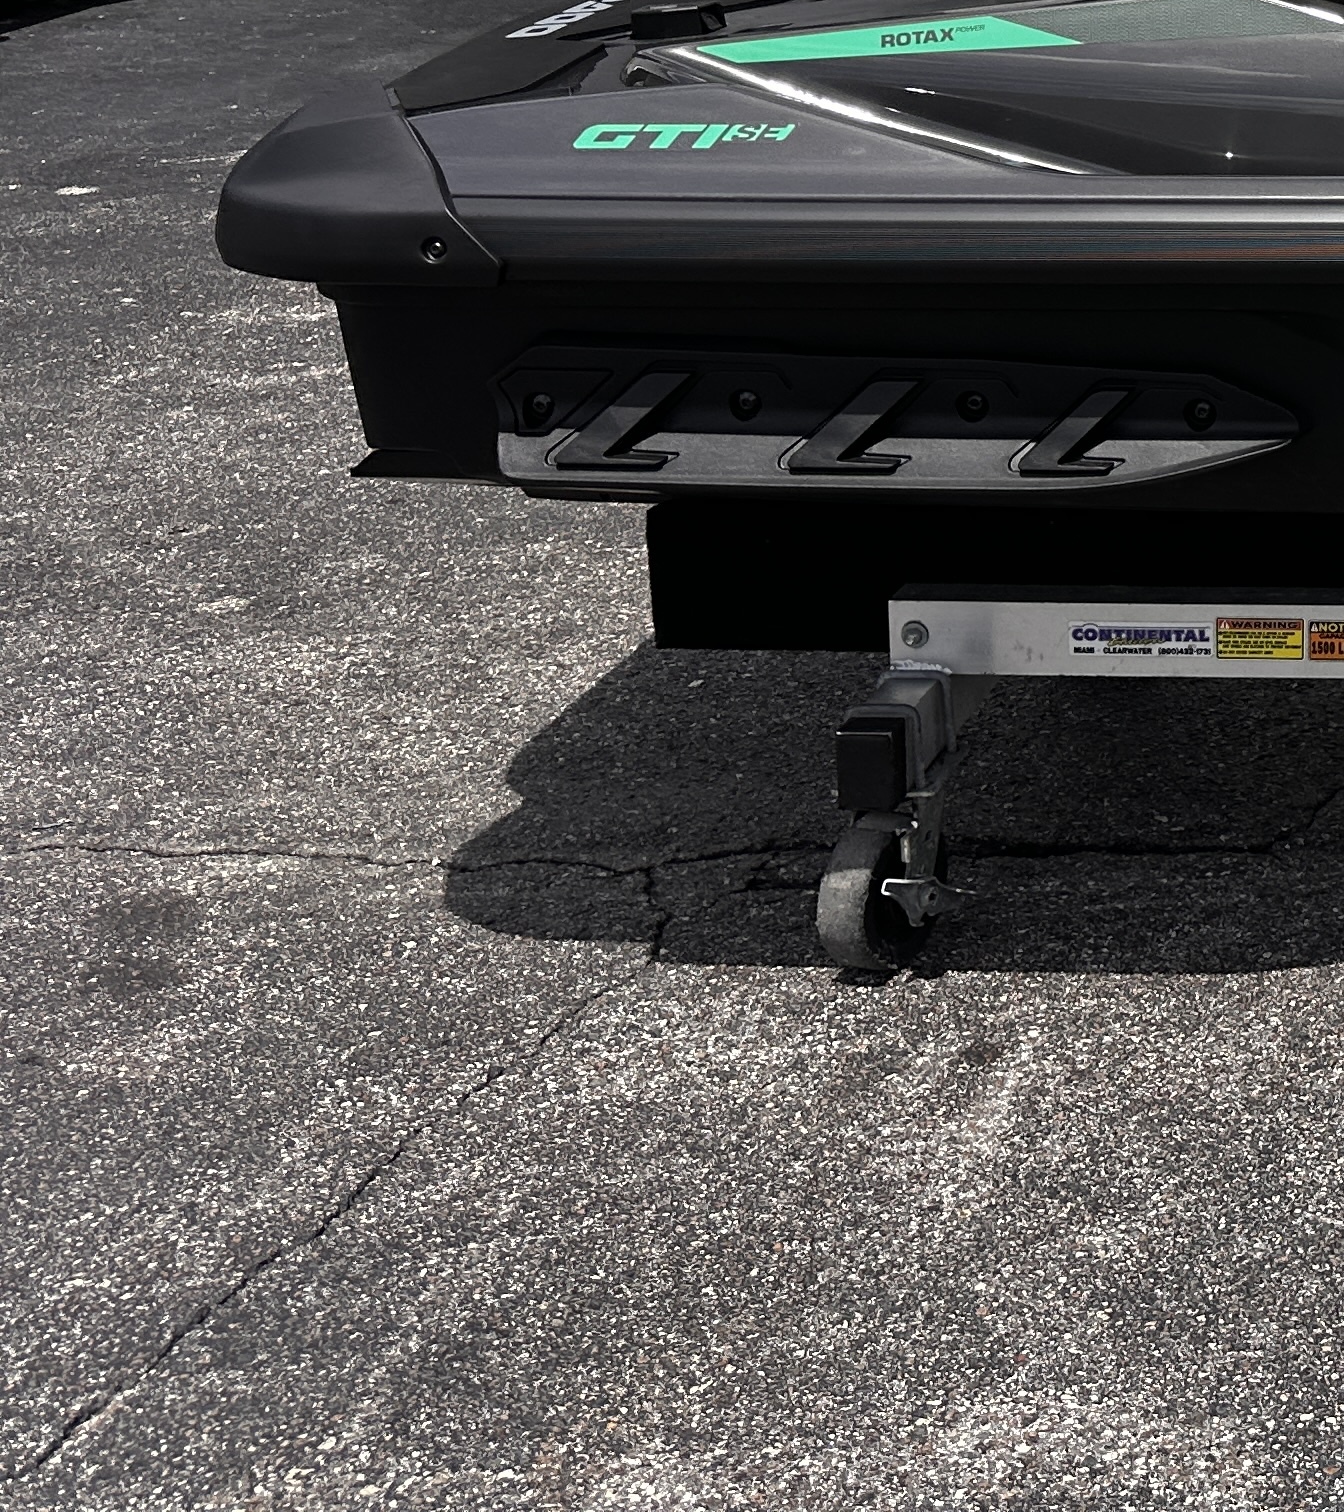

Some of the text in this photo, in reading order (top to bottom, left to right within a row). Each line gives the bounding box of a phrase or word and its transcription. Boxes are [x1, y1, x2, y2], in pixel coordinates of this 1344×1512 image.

[881, 27, 954, 48] ROTAX
[573, 123, 729, 150] GTI
[1231, 620, 1298, 629] WARNING
[1072, 628, 1210, 642] CONTINENTAL
[1103, 646, 1152, 655] CLEARWATER
[1312, 641, 1335, 655] 1500
